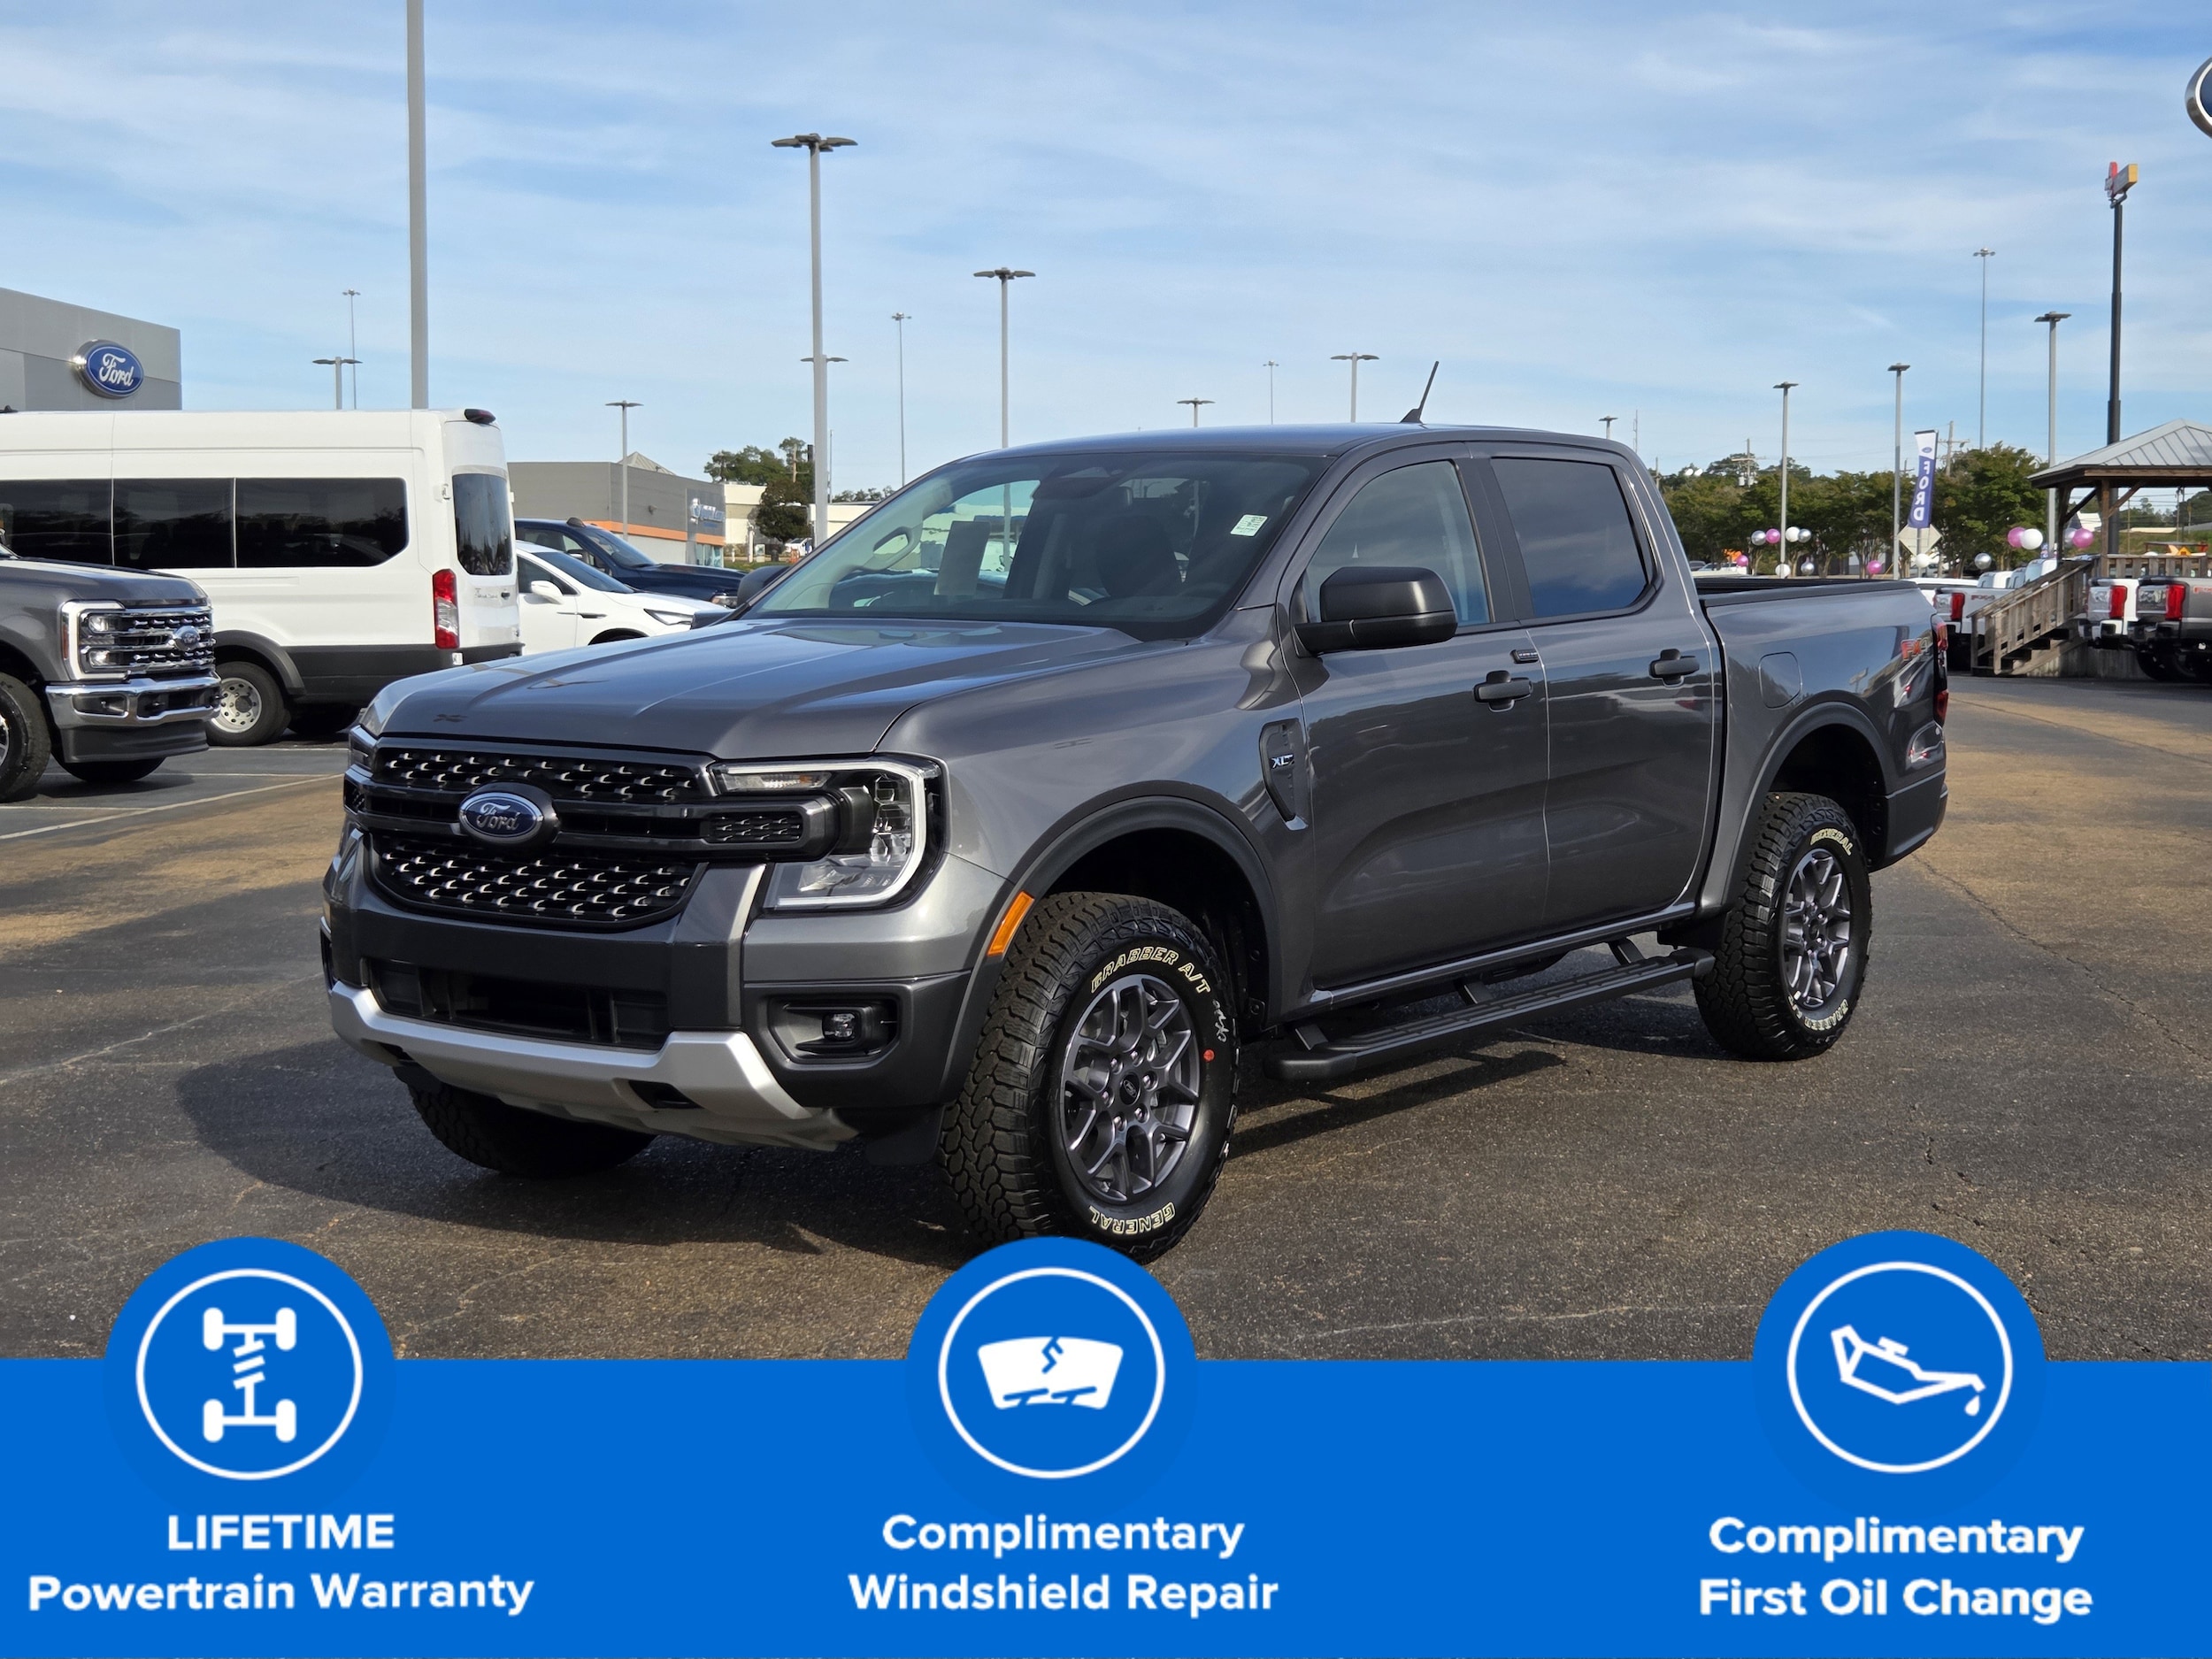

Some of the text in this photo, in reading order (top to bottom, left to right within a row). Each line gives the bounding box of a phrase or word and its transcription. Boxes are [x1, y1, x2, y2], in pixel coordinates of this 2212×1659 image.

[99, 353, 134, 387] Ford
[1901, 637, 1930, 661] FX4
[1271, 754, 1294, 769] XLT
[477, 802, 521, 830] Ford
[1091, 947, 1211, 995] GRABBER A/T
[1088, 1202, 1176, 1234] GENERAL
